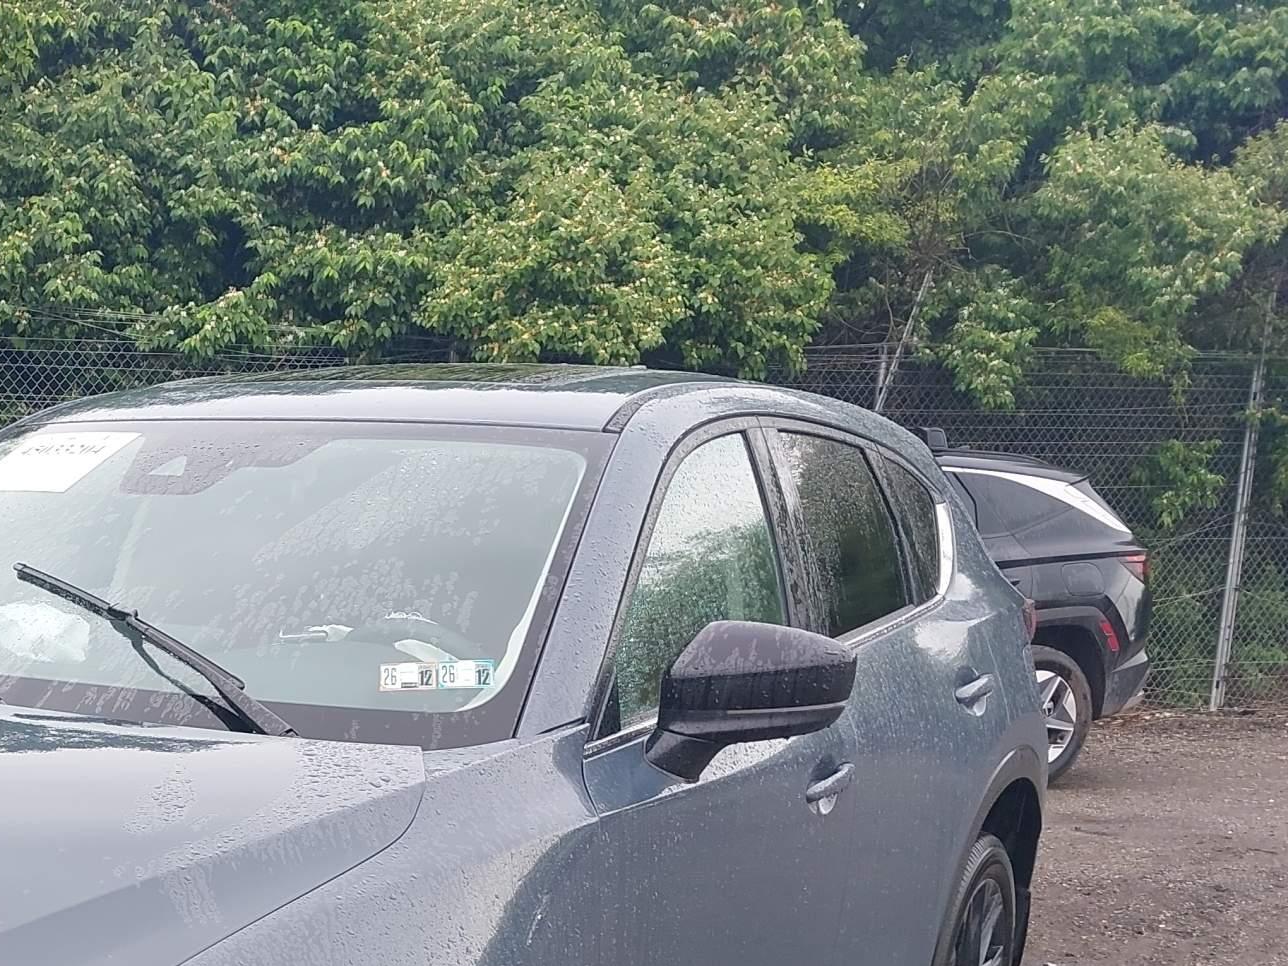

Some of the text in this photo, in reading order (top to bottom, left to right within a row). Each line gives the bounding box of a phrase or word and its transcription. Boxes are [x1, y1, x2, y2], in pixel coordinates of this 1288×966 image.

[383, 667, 433, 686] 26 12
[441, 665, 491, 686] 26 12
